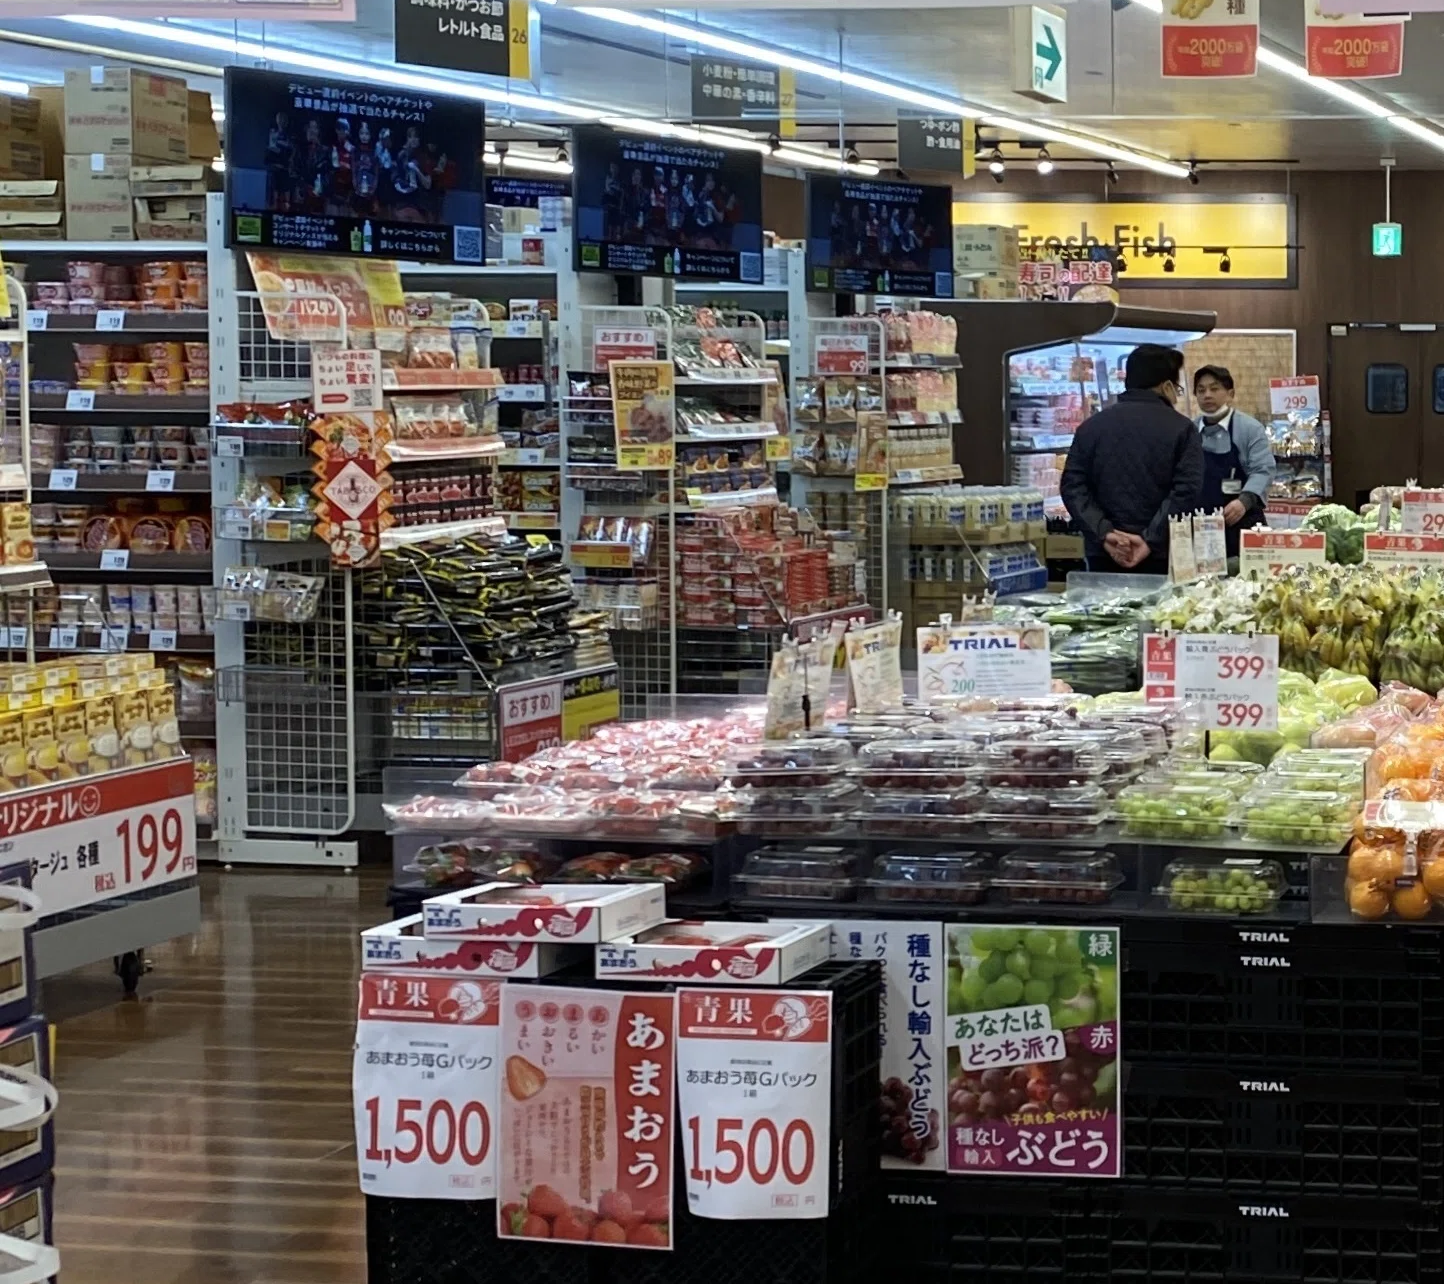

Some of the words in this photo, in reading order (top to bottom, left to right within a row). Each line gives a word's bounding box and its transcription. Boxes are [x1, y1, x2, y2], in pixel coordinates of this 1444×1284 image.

[438, 17, 504, 42] レトルト食品
[512, 28, 528, 44] 26
[1114, 222, 1176, 258] Fish
[850, 360, 867, 372] 99
[1284, 395, 1308, 409] 299
[948, 638, 1018, 650] TRIAL
[1218, 656, 1264, 679] 399
[952, 679, 976, 694] 200
[1217, 704, 1263, 726] 399
[76, 841, 100, 869] 各種
[117, 809, 182, 885] 199
[1088, 933, 1113, 957] 緑
[1239, 931, 1290, 943] TRIAL
[1240, 956, 1290, 968] TRIAL
[374, 981, 430, 1008] 青果
[694, 995, 754, 1024] 青果
[954, 1008, 1045, 1039] あなたは
[906, 932, 932, 1140] 種なし輸入ぶどう
[1089, 1025, 1114, 1050] 赤
[365, 1051, 493, 1071] あまおう苺Gパック
[967, 1034, 1060, 1065] どっち派?
[686, 1069, 818, 1088] あまおう苺Gパック
[1240, 1080, 1290, 1092] TRIAL
[623, 1011, 666, 1190] あまおう
[365, 1096, 491, 1170] 1,500
[955, 1127, 1005, 1146] 種なし
[687, 1117, 815, 1191] 1,500
[963, 1149, 995, 1165] 輸入
[1006, 1130, 1110, 1170] ぶどう
[888, 1194, 937, 1205] TRIAL
[1239, 1206, 1289, 1218] TRIAL
